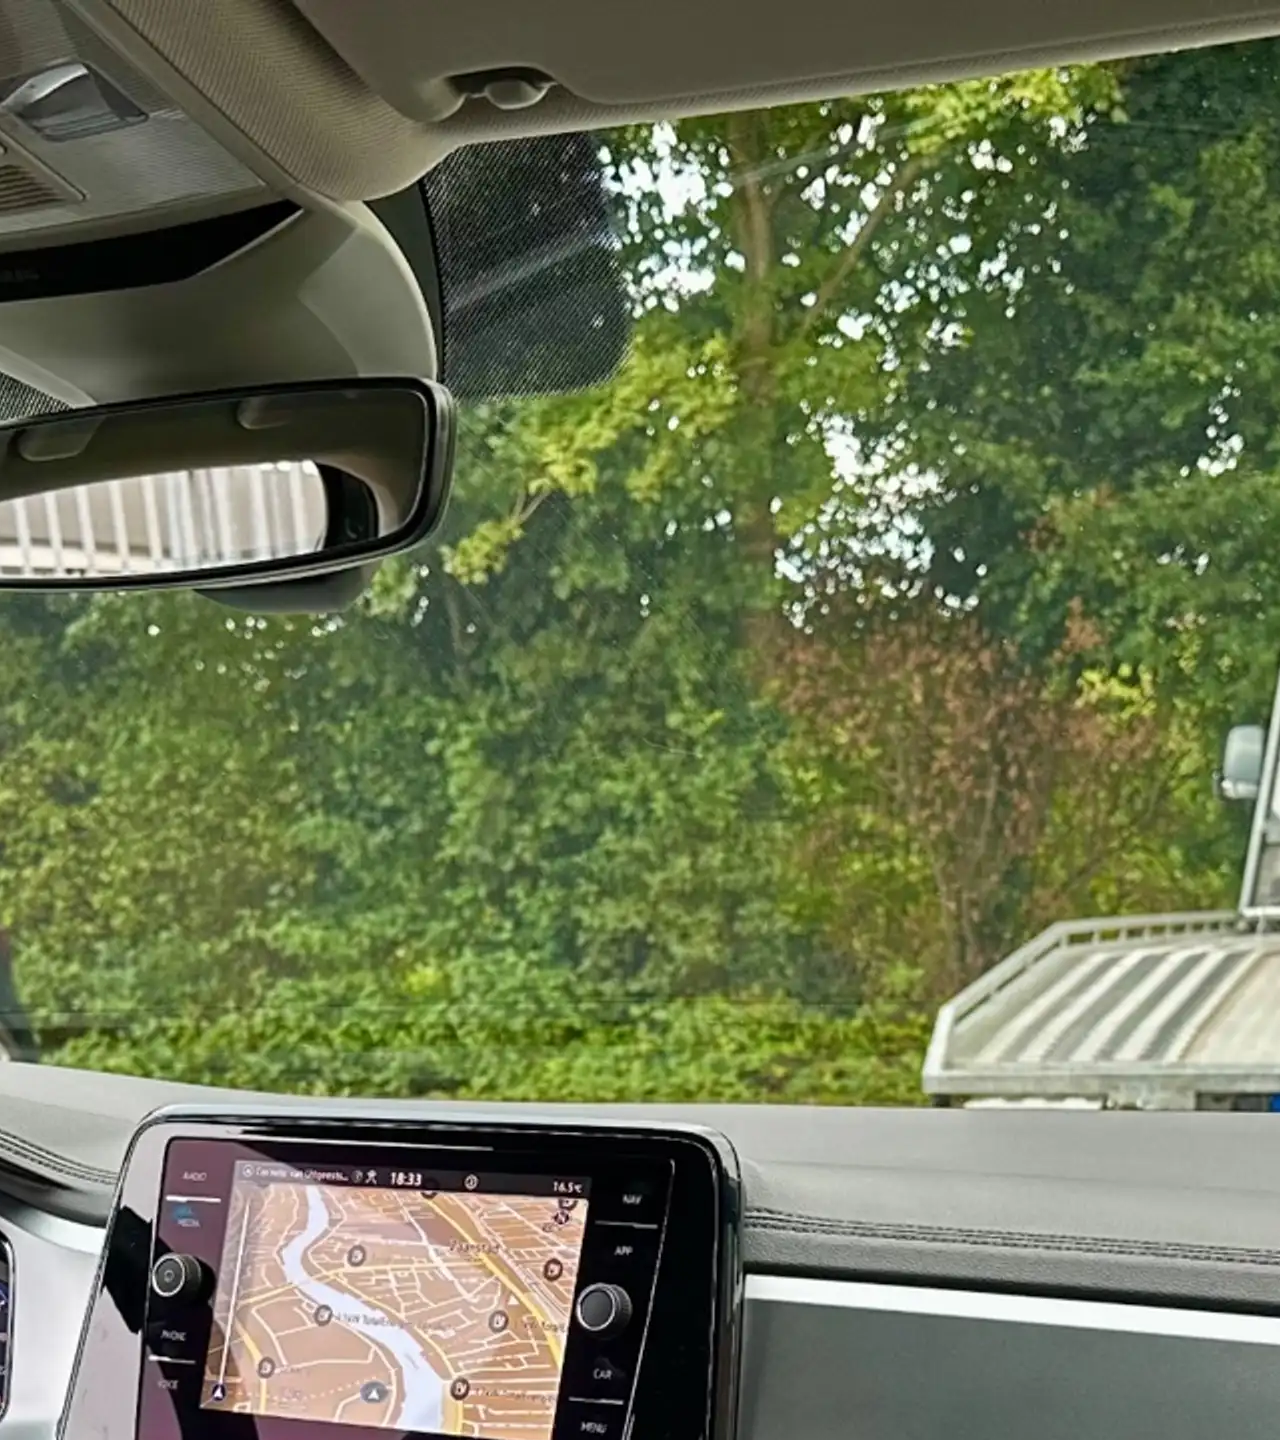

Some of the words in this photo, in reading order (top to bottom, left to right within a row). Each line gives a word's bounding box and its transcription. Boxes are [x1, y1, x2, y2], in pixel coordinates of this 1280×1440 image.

[390, 1171, 422, 1187] 18:33
[622, 1194, 643, 1205] NAV
[614, 1245, 634, 1256] APP
[593, 1368, 613, 1380] CAR
[580, 1421, 608, 1435] MENU
